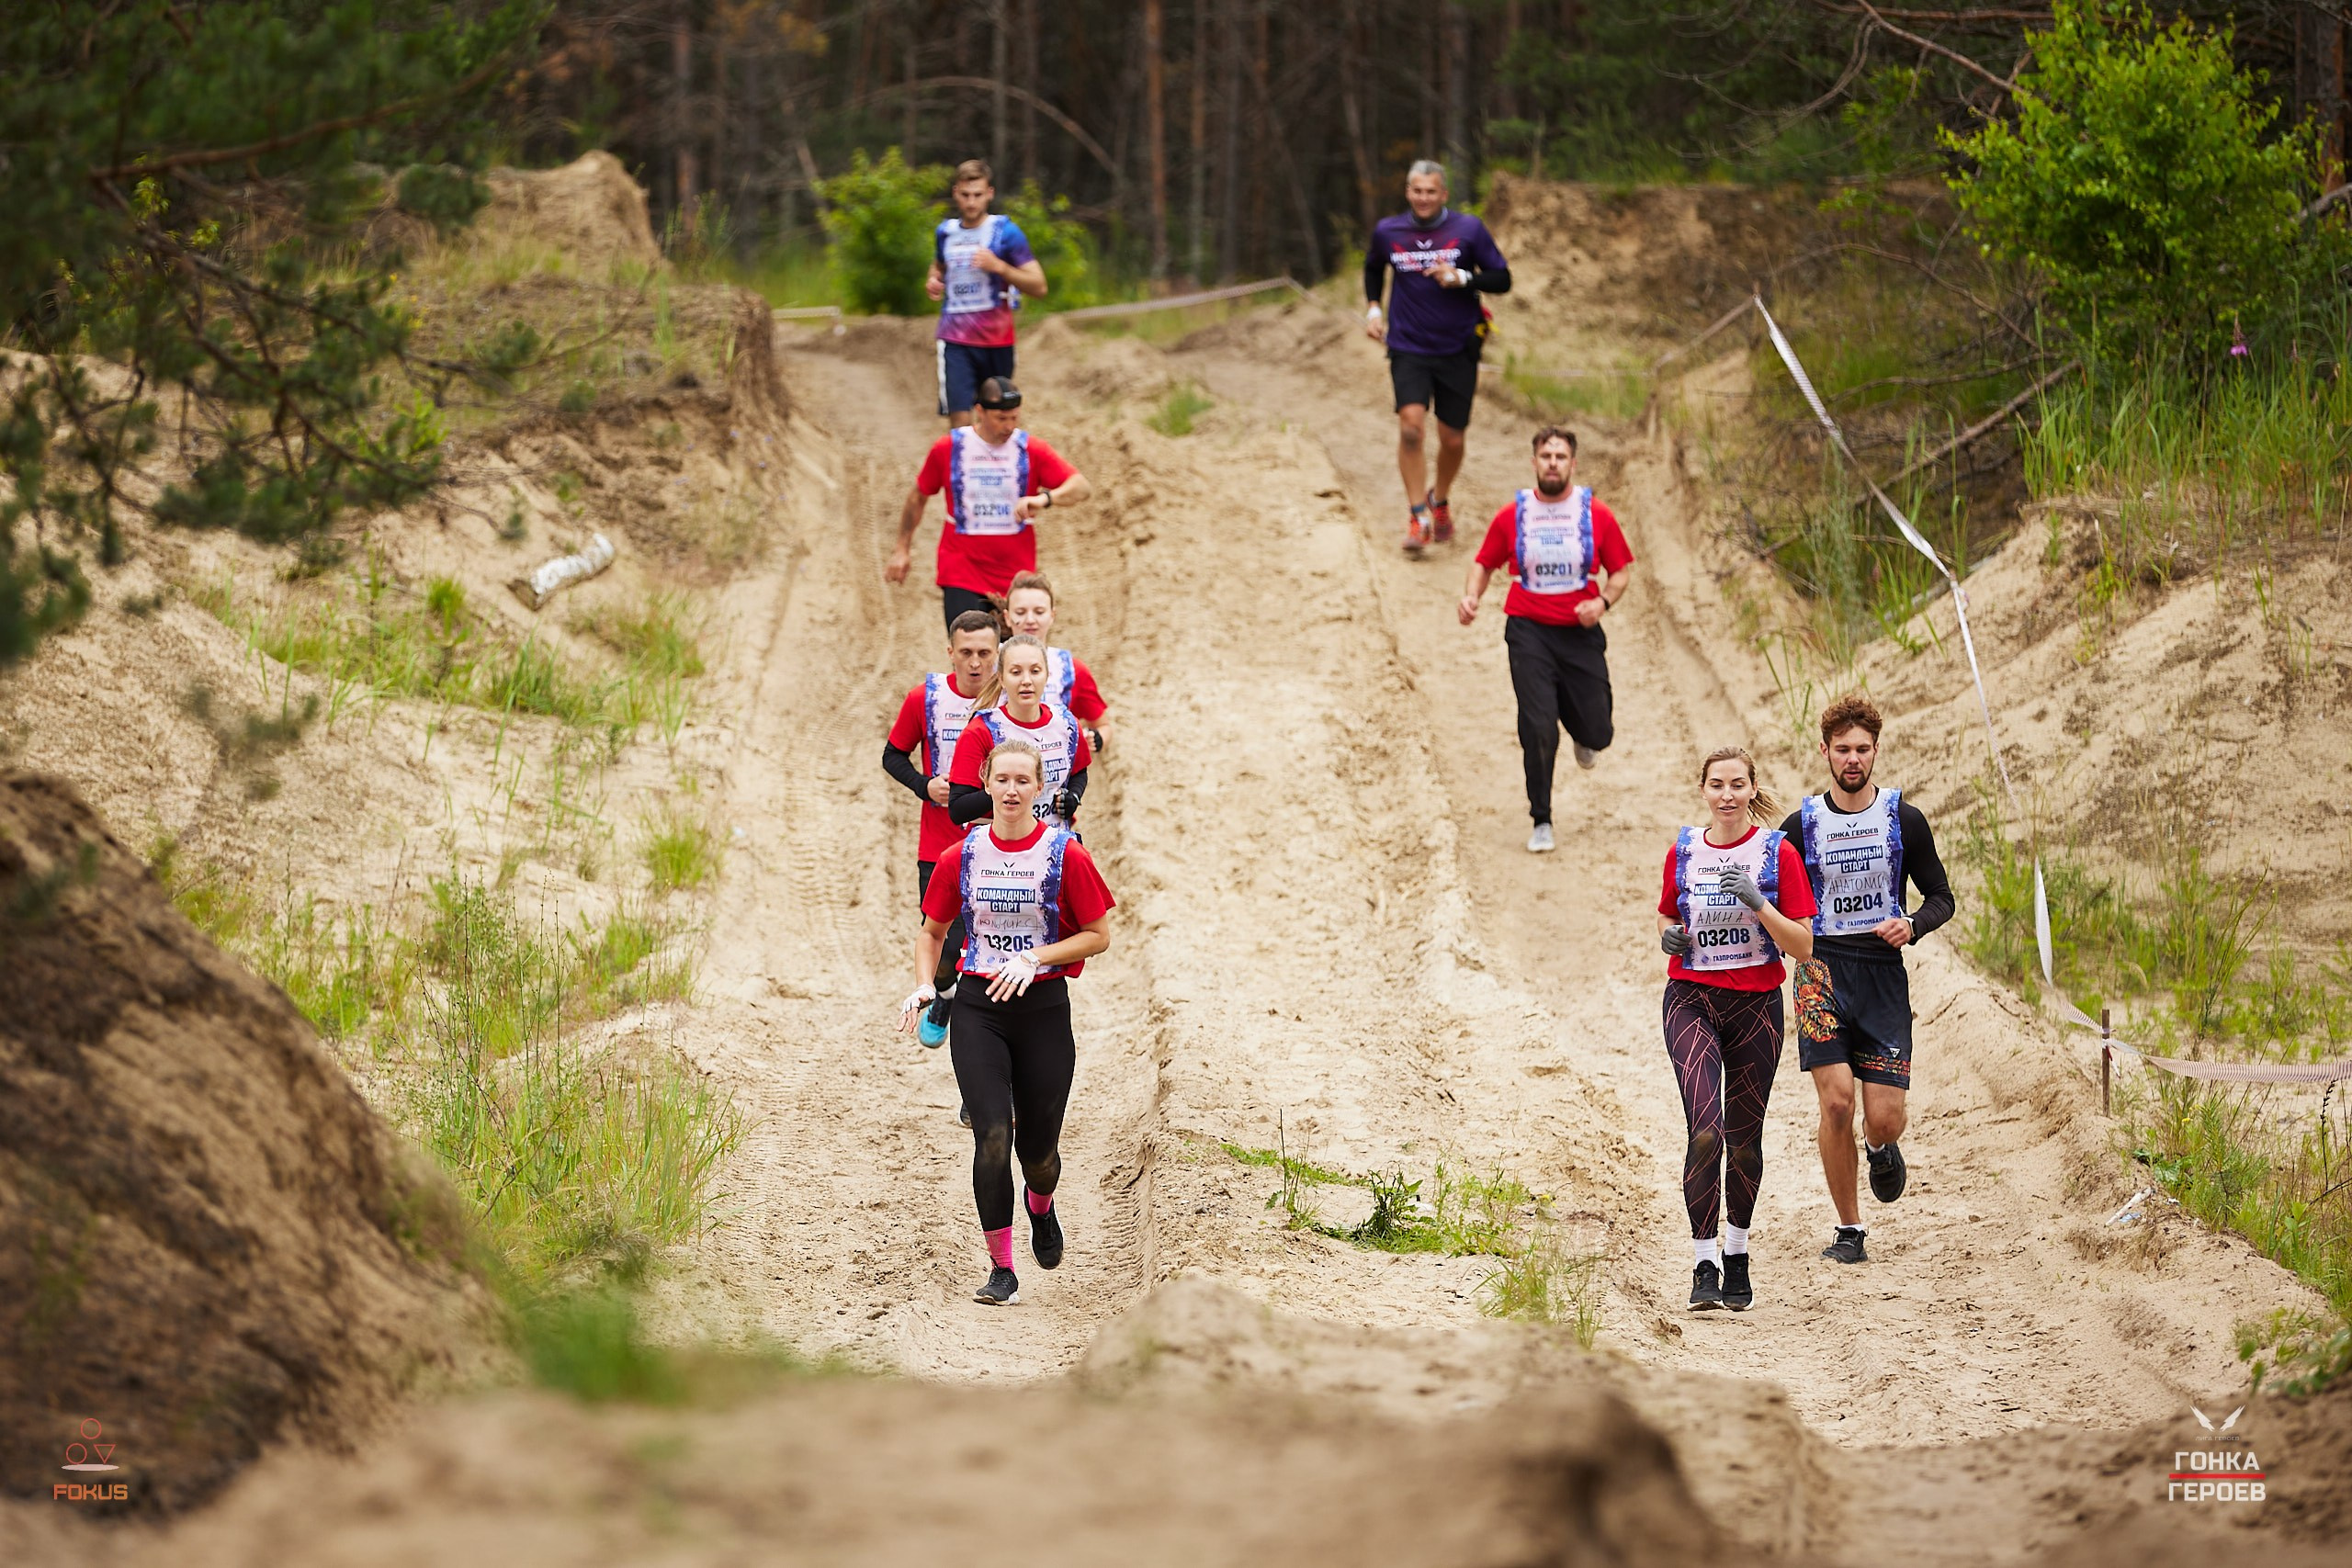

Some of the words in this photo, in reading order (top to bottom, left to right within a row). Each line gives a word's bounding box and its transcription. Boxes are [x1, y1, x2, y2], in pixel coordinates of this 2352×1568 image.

[1535, 563, 1573, 576] 03201
[1041, 741, 1062, 750] ГЕРОЕВ
[1826, 830, 1849, 840] ГОНКА
[1851, 828, 1879, 837] ГЕРОЕВ
[1826, 845, 1883, 863] КОМАНДНЫЙ
[1842, 860, 1868, 872] СТАРТ
[977, 888, 1035, 902] КОМАНДНЫЙ
[1709, 895, 1736, 906] СТАРТ
[992, 901, 1019, 912] СТАРТ
[1833, 892, 1883, 914] 03204
[1697, 910, 1746, 925] АЛИНА
[1848, 916, 1885, 927] ГАЗПРОМБАНК
[1697, 928, 1751, 948] 03208
[1713, 951, 1753, 963] ГАЗПРОМБАНК
